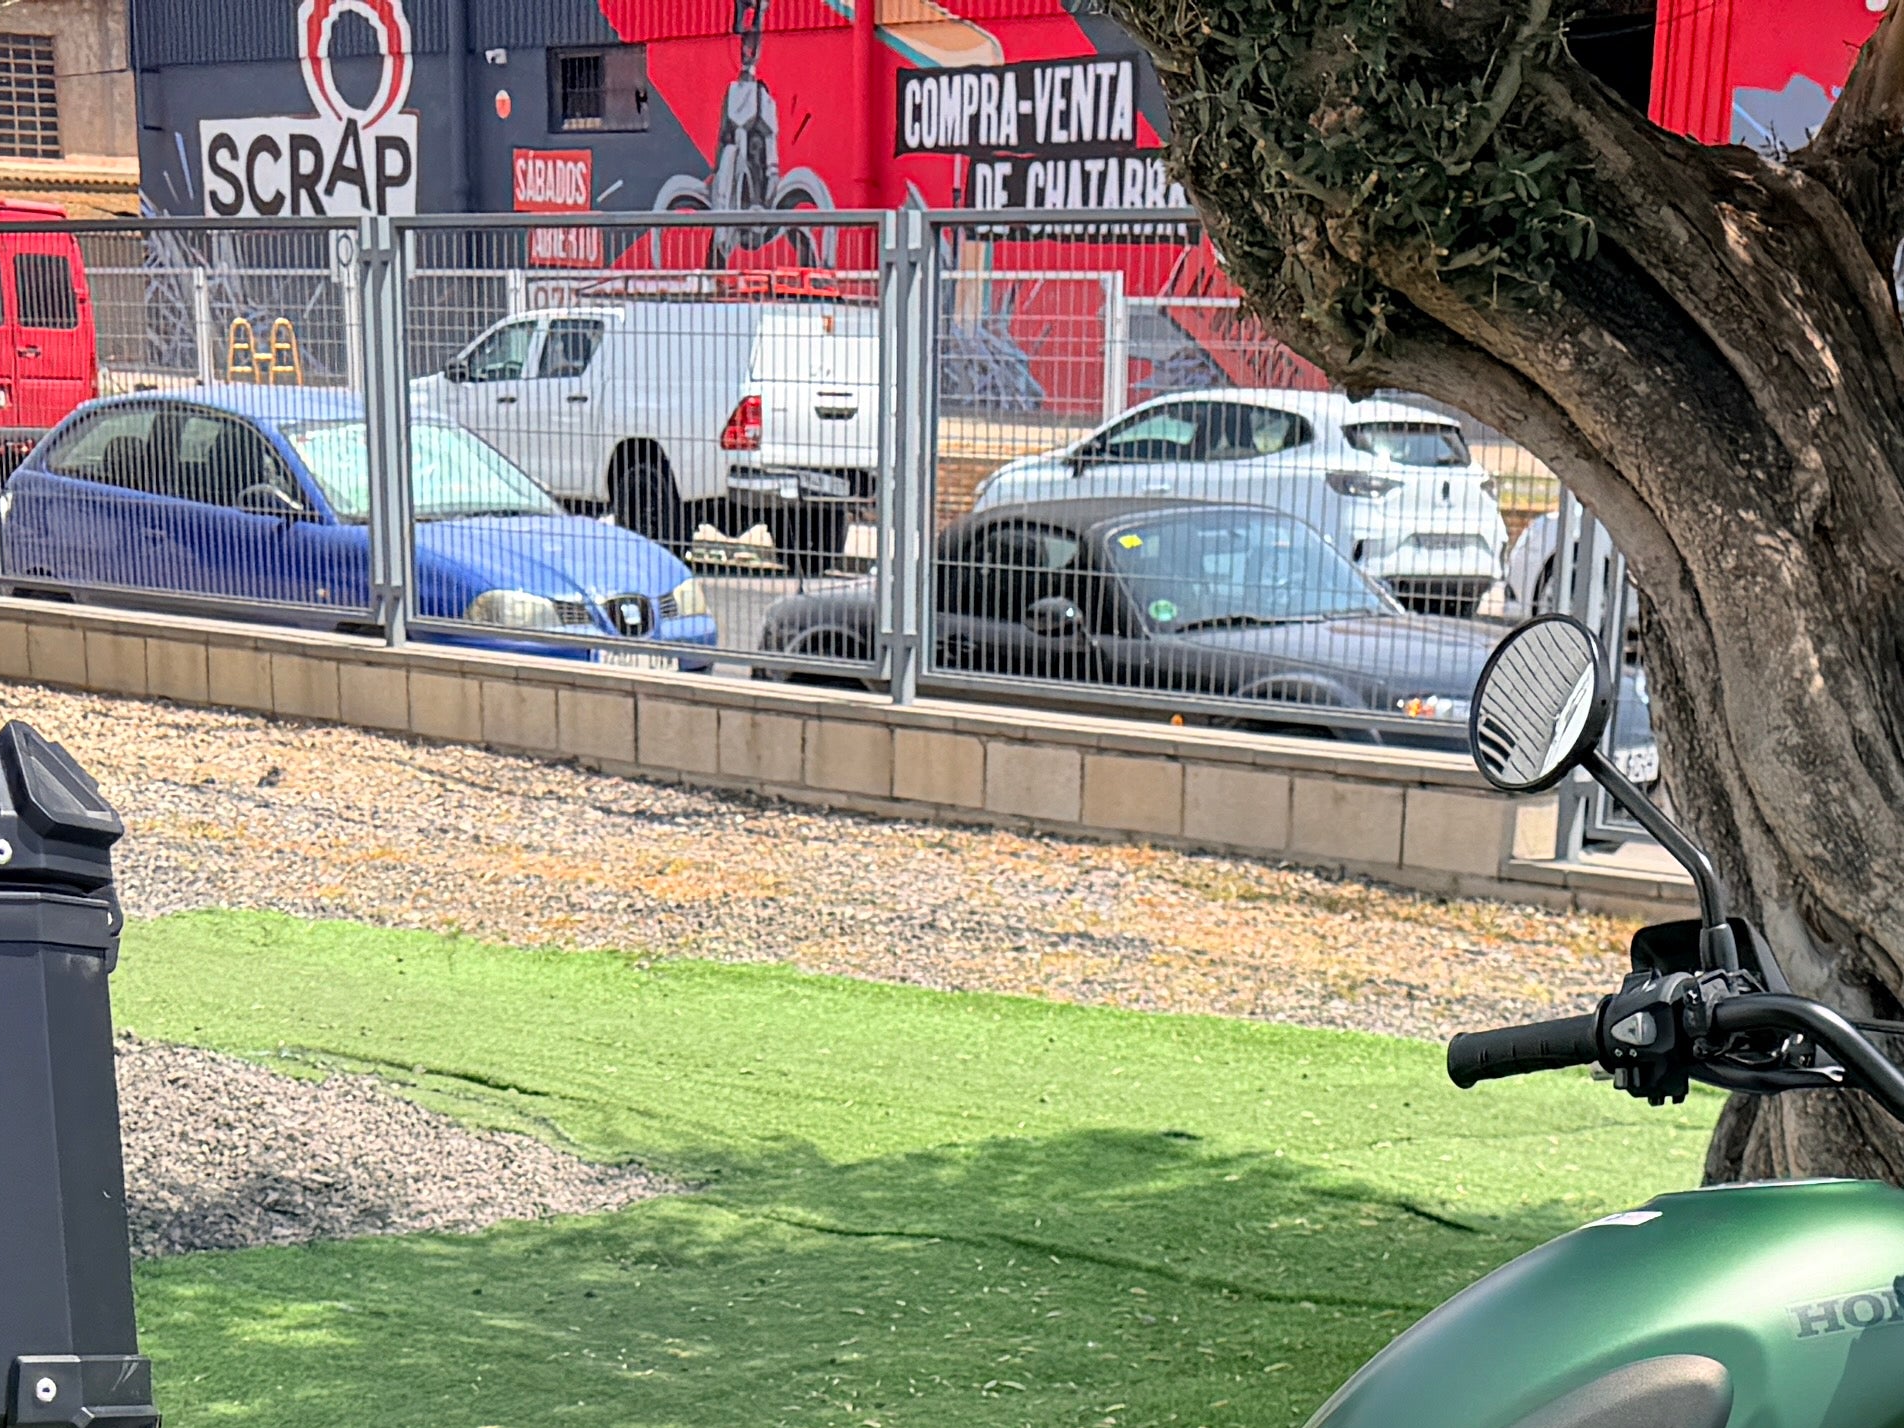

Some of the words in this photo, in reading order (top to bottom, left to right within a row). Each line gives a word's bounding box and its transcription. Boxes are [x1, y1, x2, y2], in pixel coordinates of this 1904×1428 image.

[904, 61, 1134, 149] COMPRA-VENTA
[208, 117, 412, 216] SCRAP
[516, 150, 587, 206] SÁBADOS
[975, 162, 1013, 234] DE
